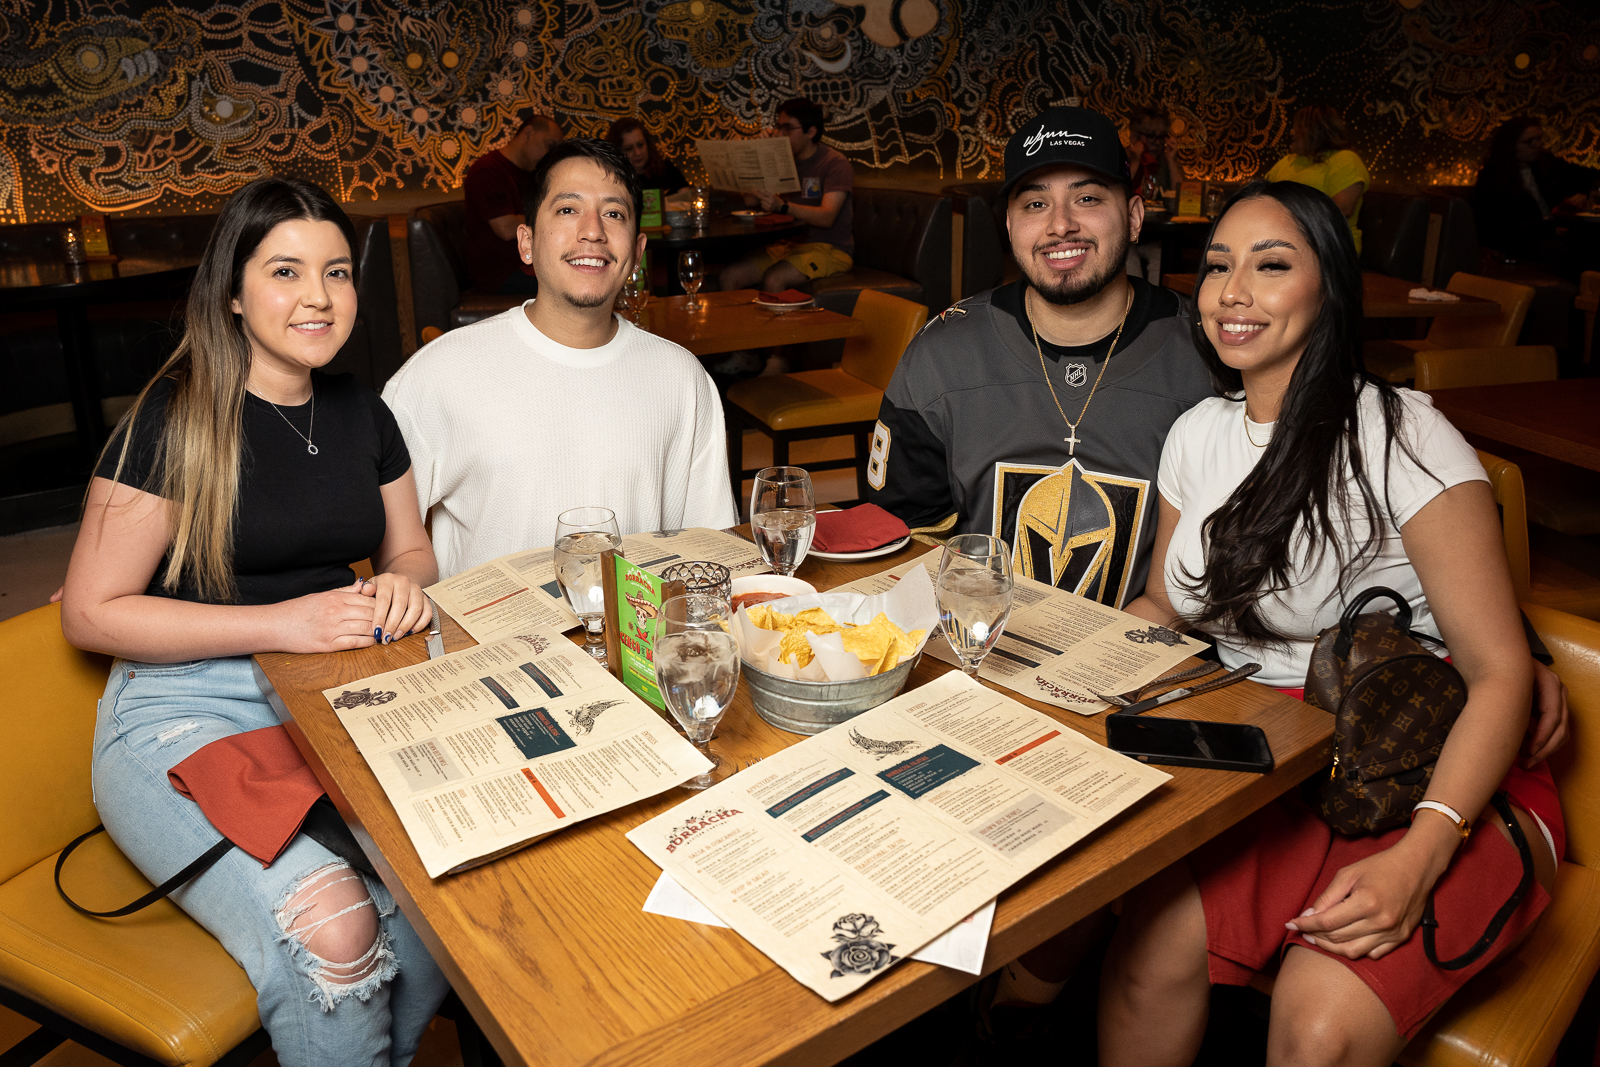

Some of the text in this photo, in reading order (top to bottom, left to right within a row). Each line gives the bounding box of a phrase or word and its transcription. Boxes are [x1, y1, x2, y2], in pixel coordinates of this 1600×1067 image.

[1070, 370, 1083, 381] NHL
[867, 419, 891, 492] 8
[620, 631, 640, 654] CINCO
[1035, 675, 1096, 704] BORRACHA
[666, 808, 744, 854] BORRACHA
